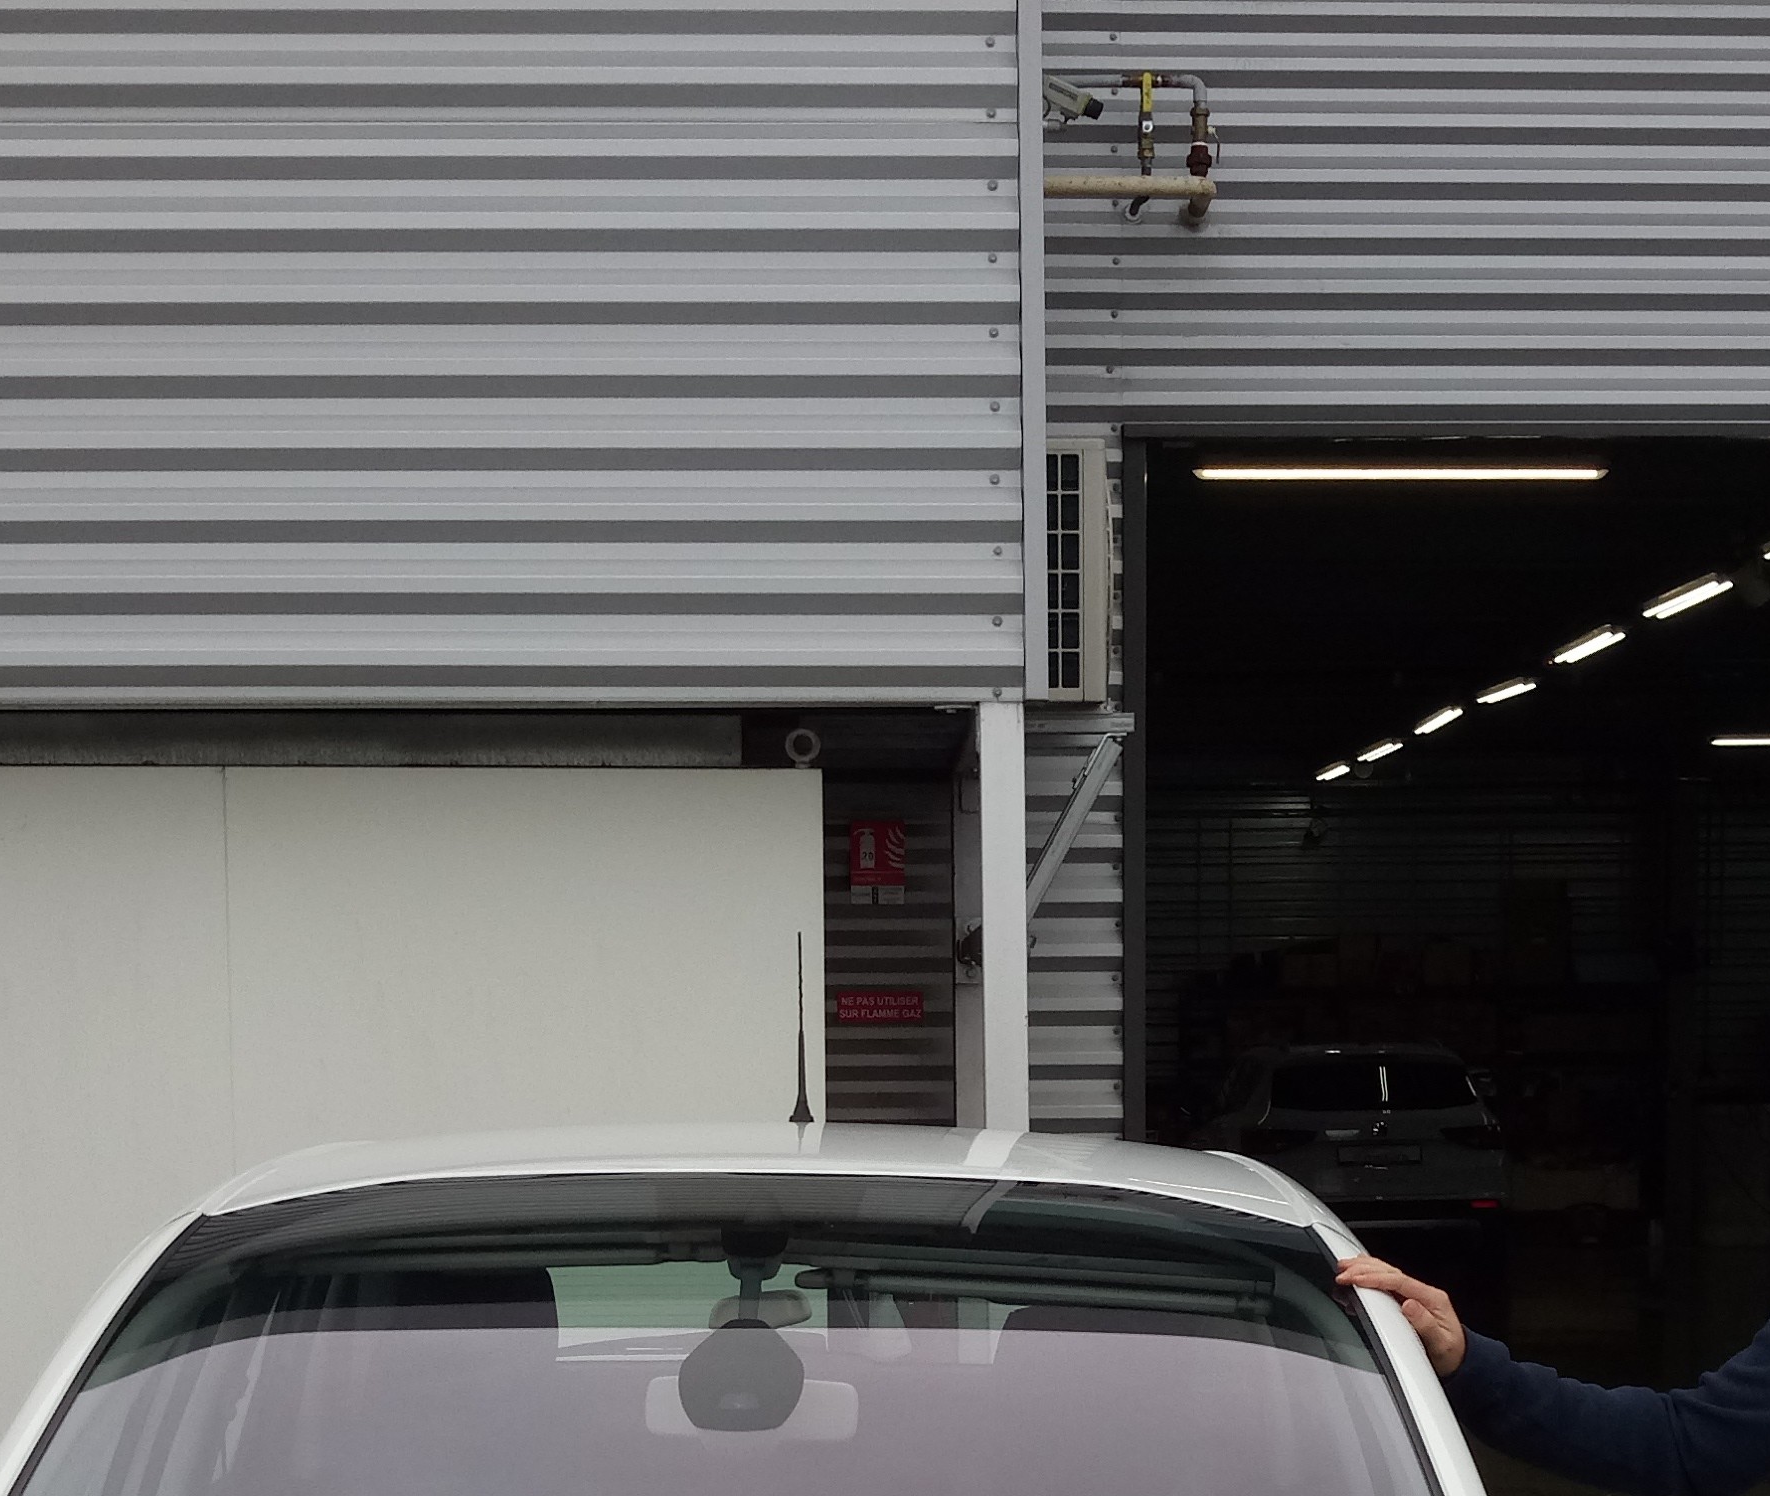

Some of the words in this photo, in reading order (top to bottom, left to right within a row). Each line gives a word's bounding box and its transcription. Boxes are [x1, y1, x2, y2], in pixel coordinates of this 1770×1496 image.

[841, 996, 854, 1006] NE
[856, 996, 875, 1006] PAS
[877, 996, 919, 1006] UTILISER
[839, 1009, 859, 1018] SUR
[861, 1009, 900, 1018] FLAMME
[902, 1009, 922, 1018] GAZ
